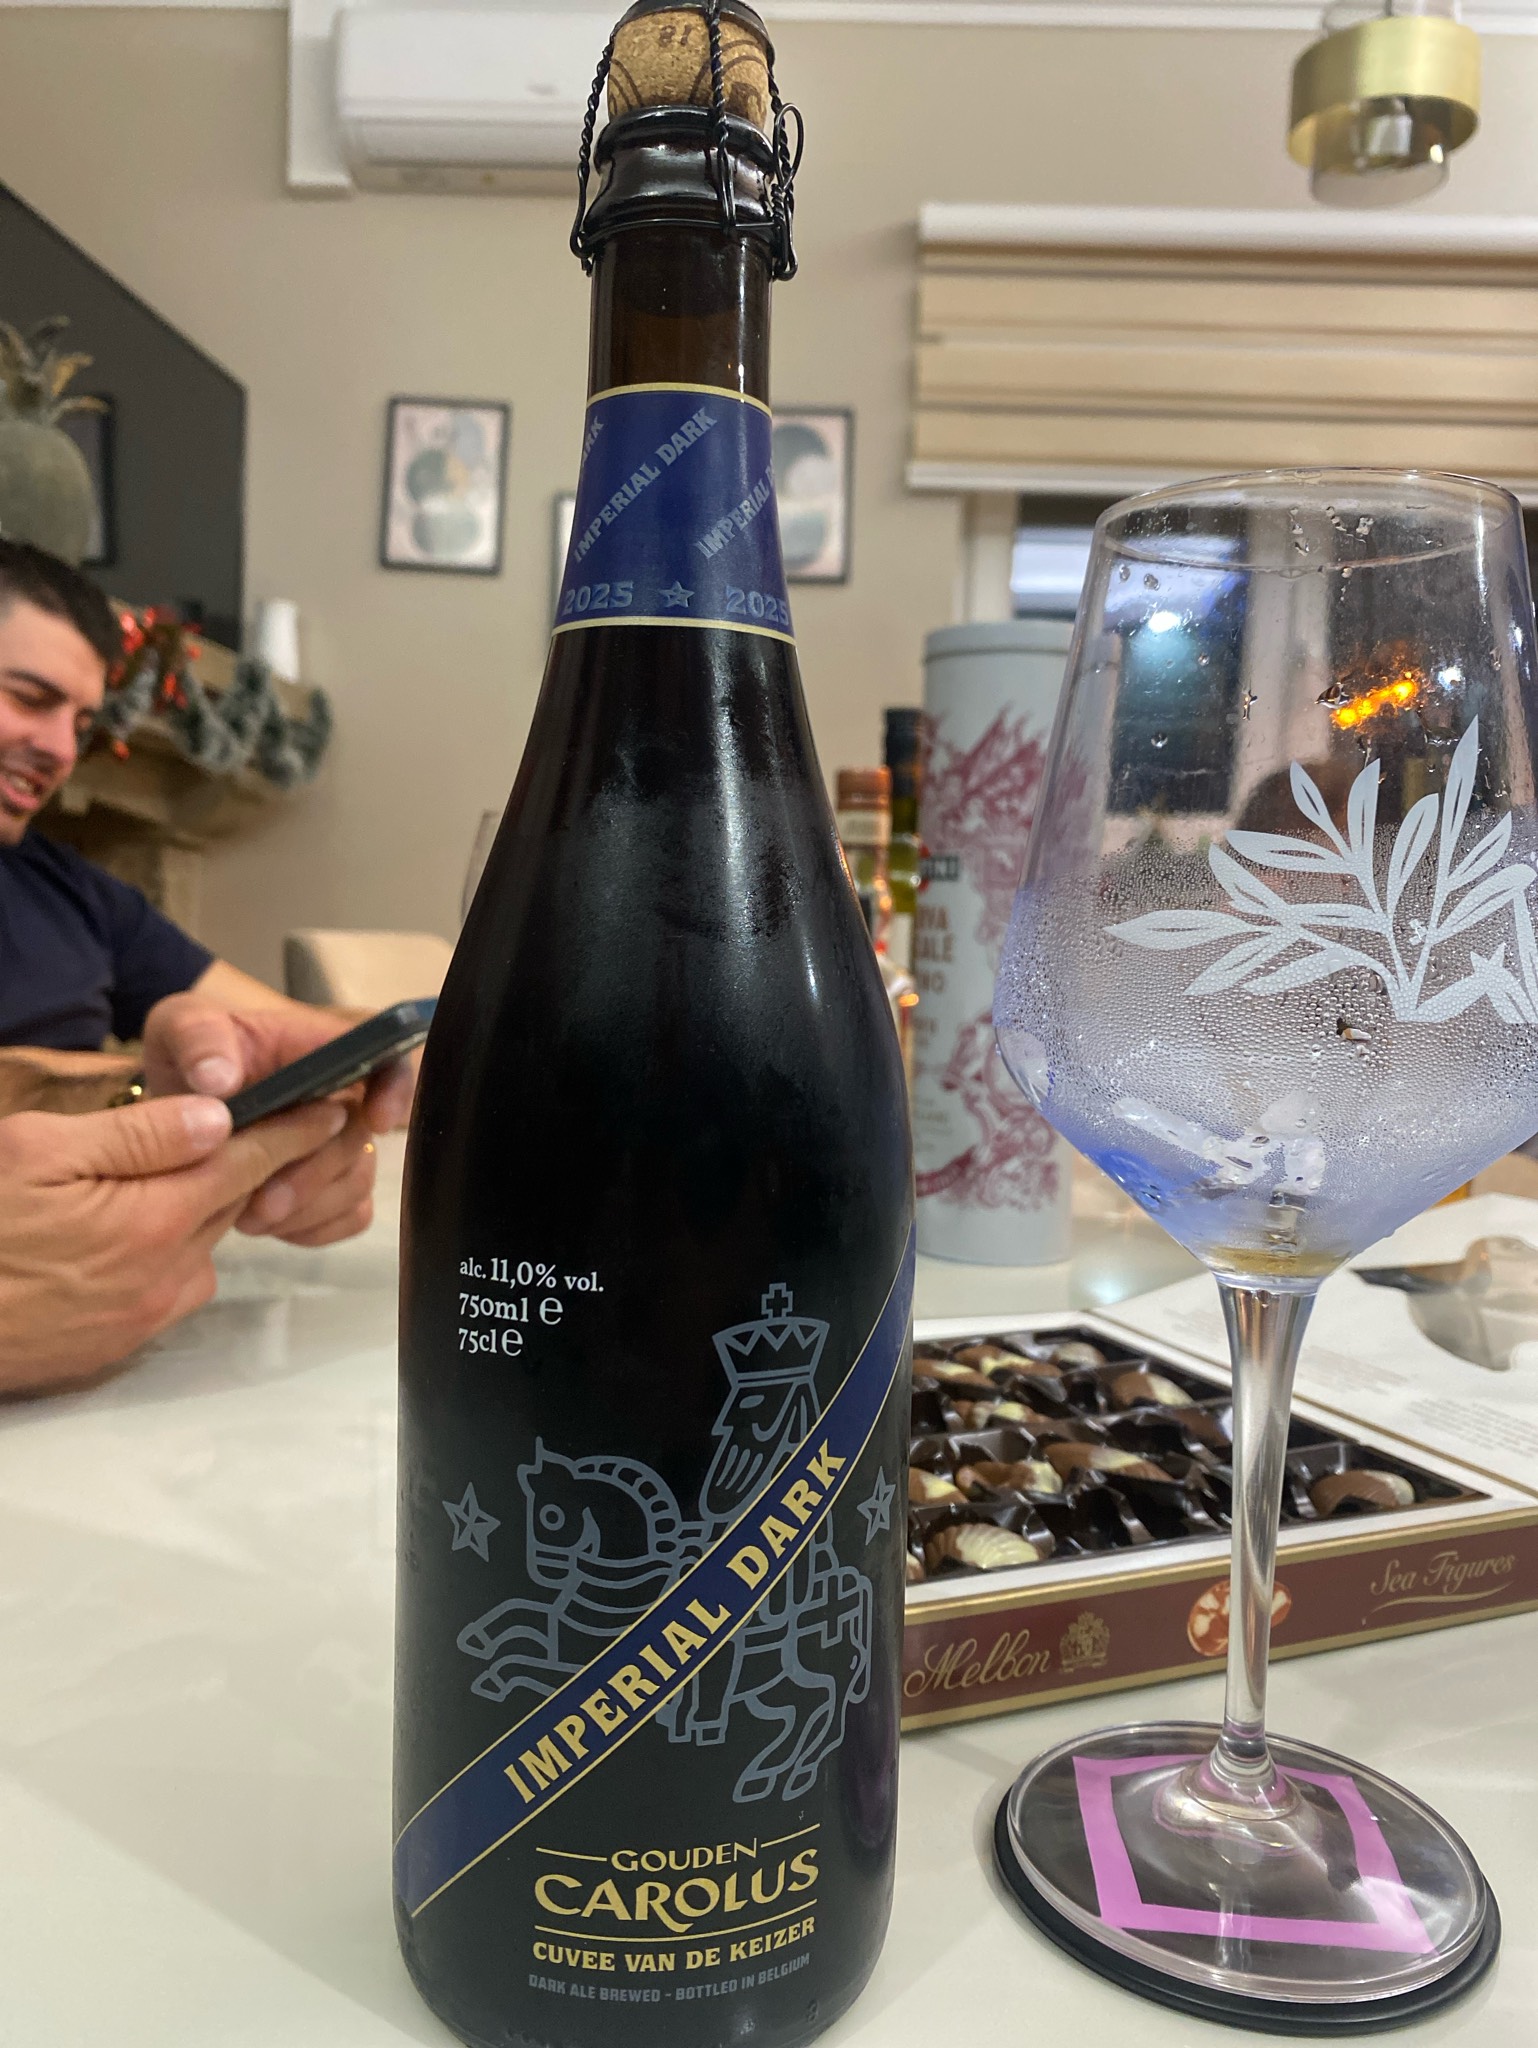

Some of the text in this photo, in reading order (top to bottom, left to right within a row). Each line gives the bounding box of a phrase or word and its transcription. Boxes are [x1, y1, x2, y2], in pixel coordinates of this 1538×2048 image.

[573, 407, 718, 563] IMPERIAL DARK
[693, 477, 770, 560] IMPERIAL
[561, 580, 789, 626] 2025 2025
[459, 1257, 604, 1293] alc. 11,0% vol.
[458, 1292, 530, 1323] 750ml
[458, 1327, 498, 1354] 75cl
[1370, 1550, 1517, 1596] Sea Figures
[503, 1437, 847, 1804] IMPERIAL DARK
[903, 1628, 1051, 1699] Melbon
[610, 1837, 758, 1873] GOUDEN
[533, 1848, 820, 1934] CAROLUS
[532, 1915, 816, 1973] CUVEE VAN DE KEIZER
[528, 1973, 566, 1995] DARK
[569, 1983, 596, 1999] ALE
[599, 1987, 661, 2003] BREWED
[675, 1979, 738, 2001] BOTTLED
[741, 1974, 755, 1990] IN
[757, 1952, 810, 1986] BELGIUM
